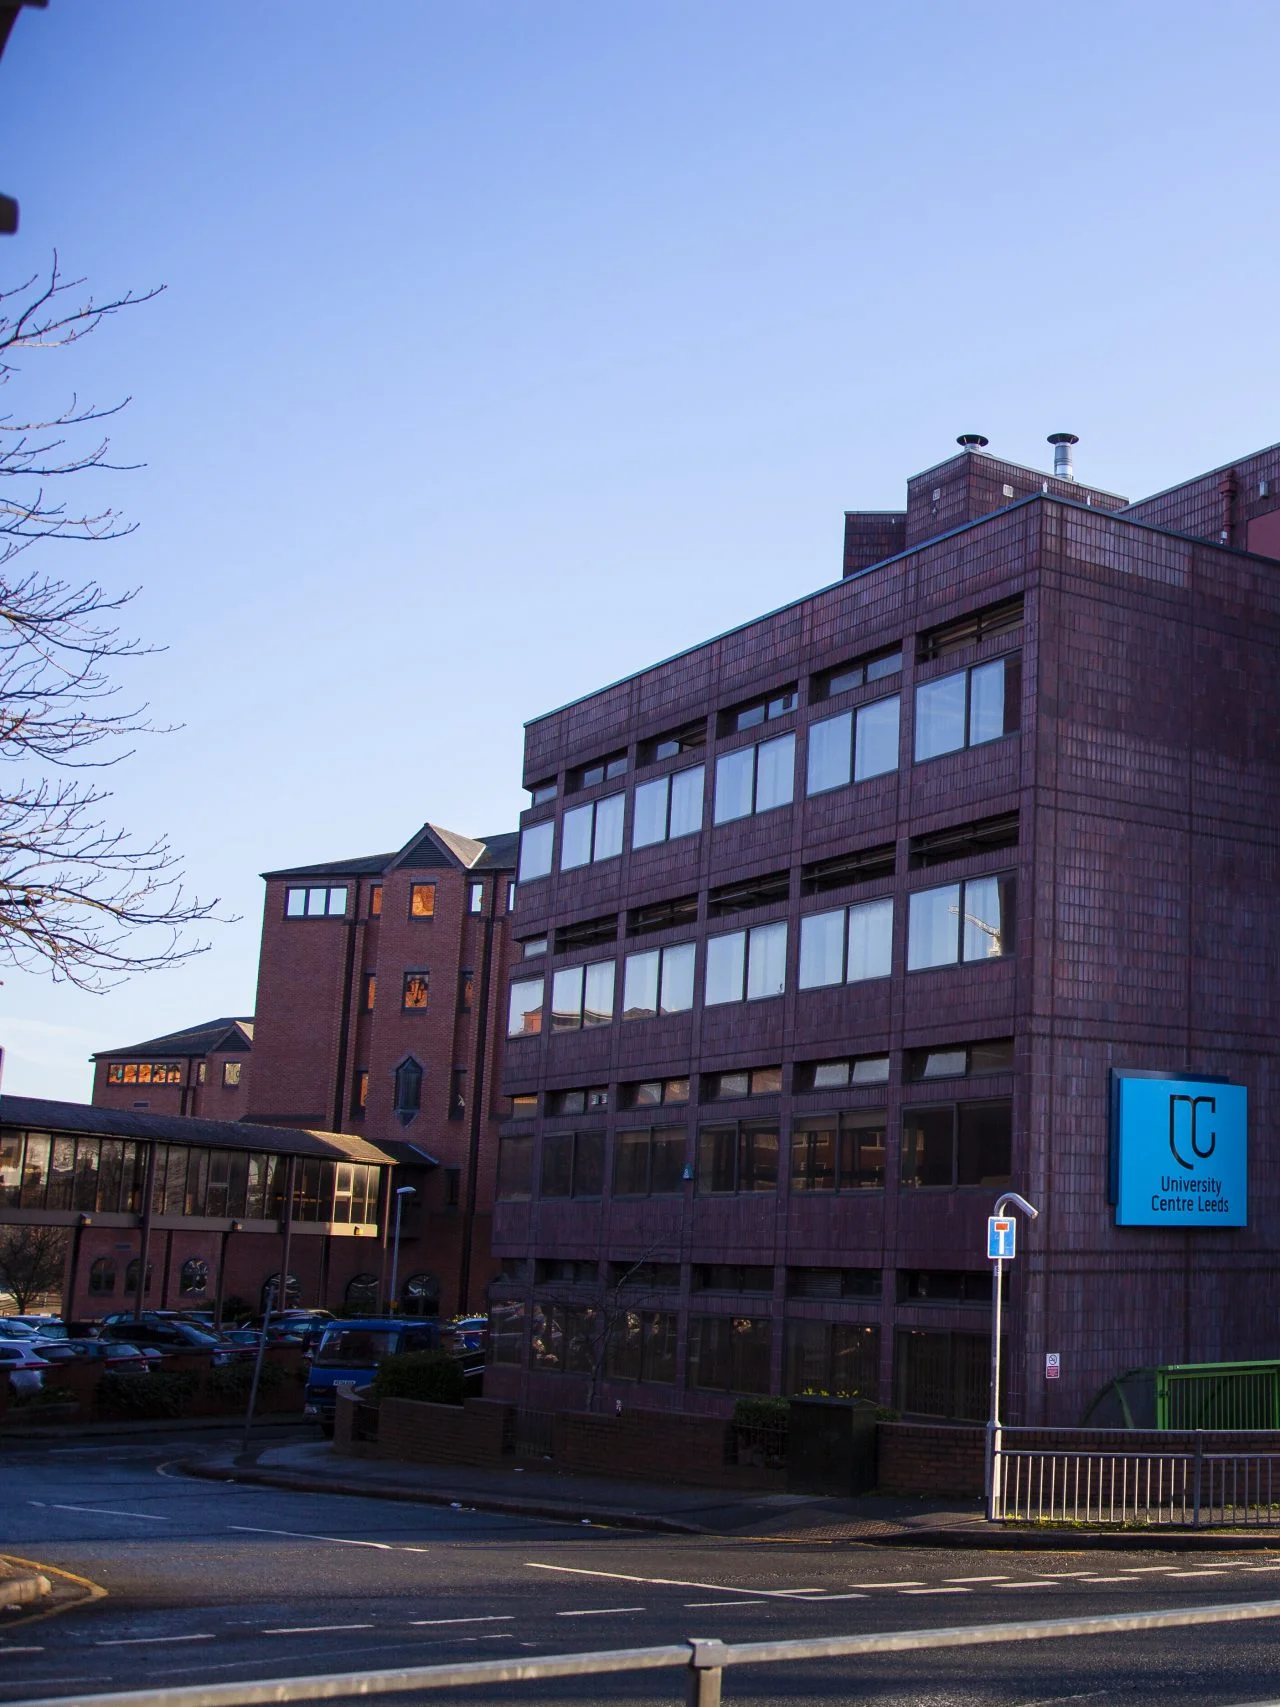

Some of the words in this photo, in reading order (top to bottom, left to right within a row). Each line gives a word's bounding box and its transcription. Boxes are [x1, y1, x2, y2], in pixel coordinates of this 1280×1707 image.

[1161, 1175, 1222, 1196] University
[1151, 1195, 1194, 1212] Centre
[1198, 1196, 1229, 1212] Leeds
